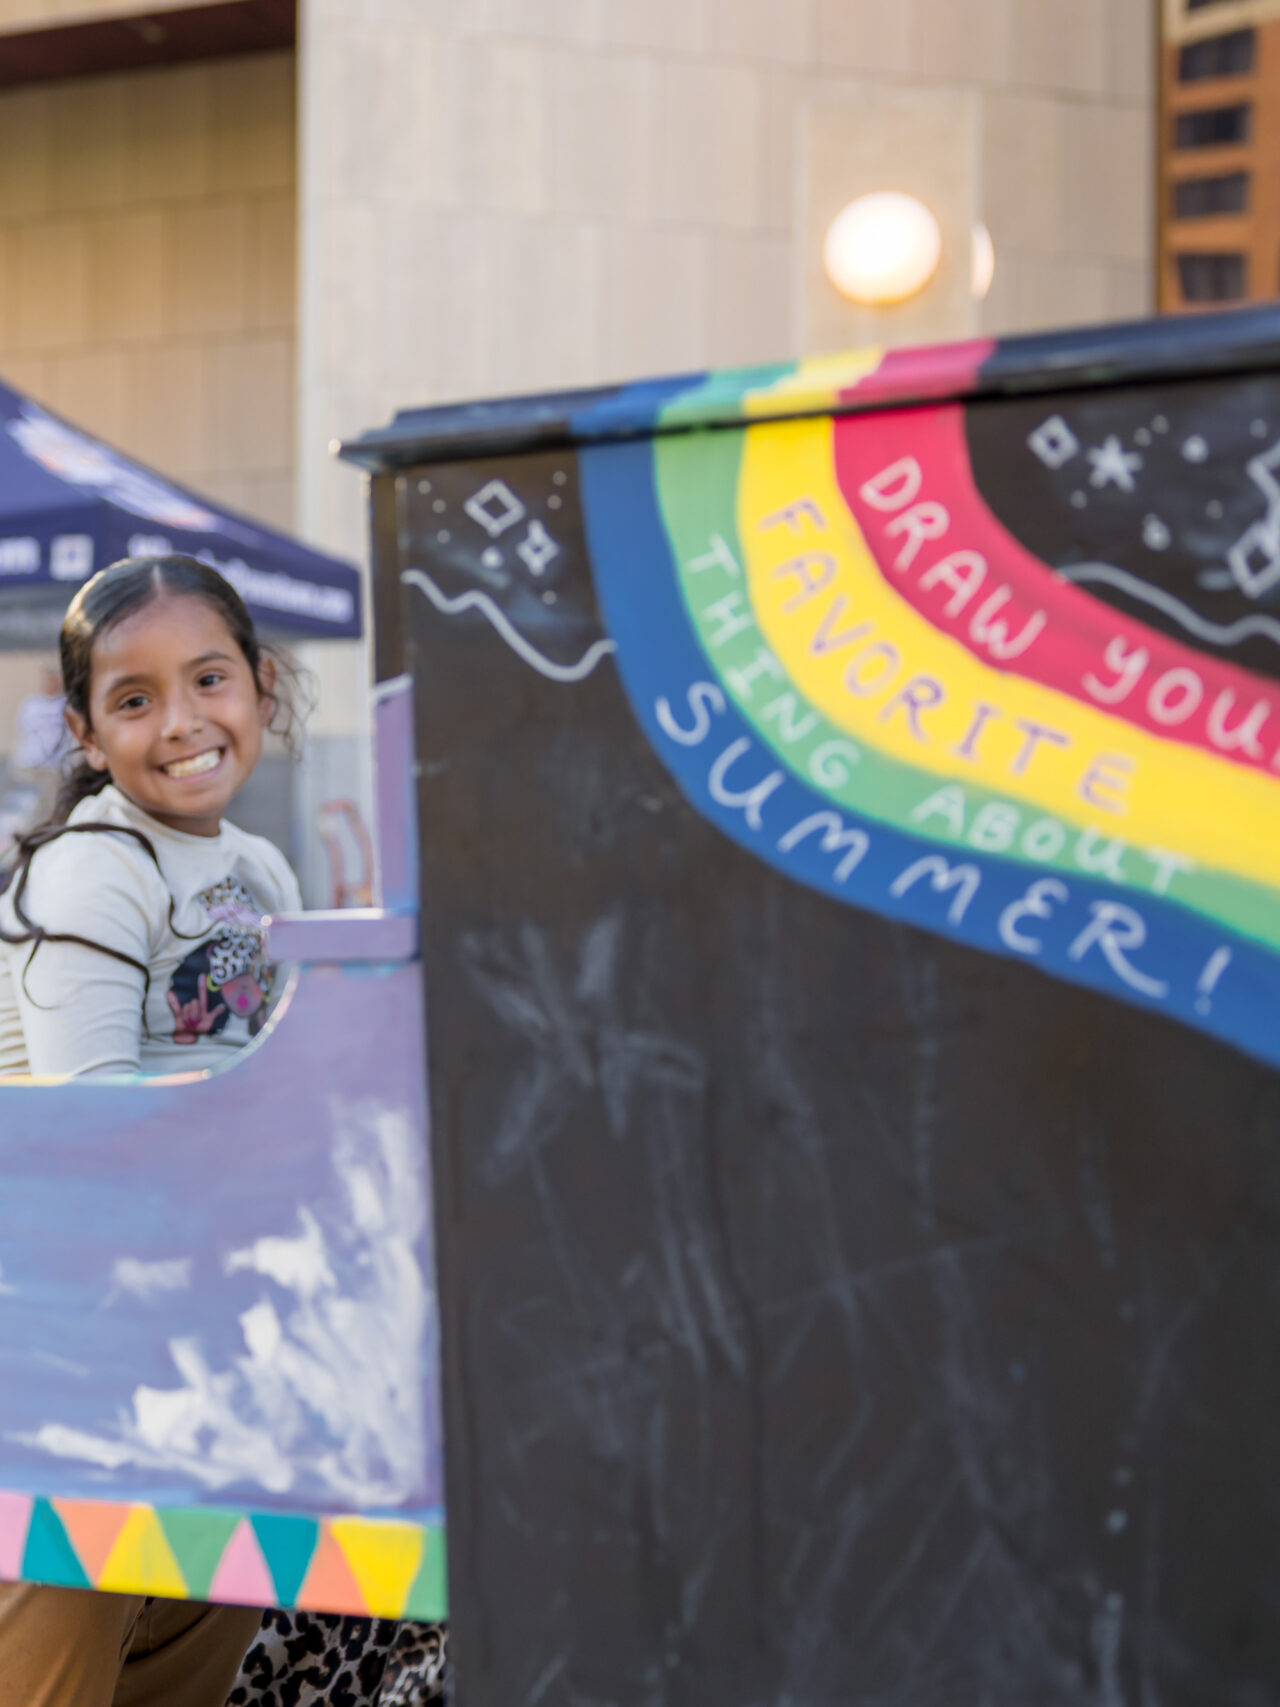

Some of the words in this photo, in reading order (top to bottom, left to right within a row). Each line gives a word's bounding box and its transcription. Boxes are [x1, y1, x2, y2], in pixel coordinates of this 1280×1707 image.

[685, 534, 863, 792] THING
[909, 780, 1196, 899] ABOUT
[756, 494, 1142, 819] FAVORITE
[859, 455, 1047, 661] DRAW
[1083, 634, 1280, 775] YOU
[655, 679, 1233, 1019] SUMMER!
